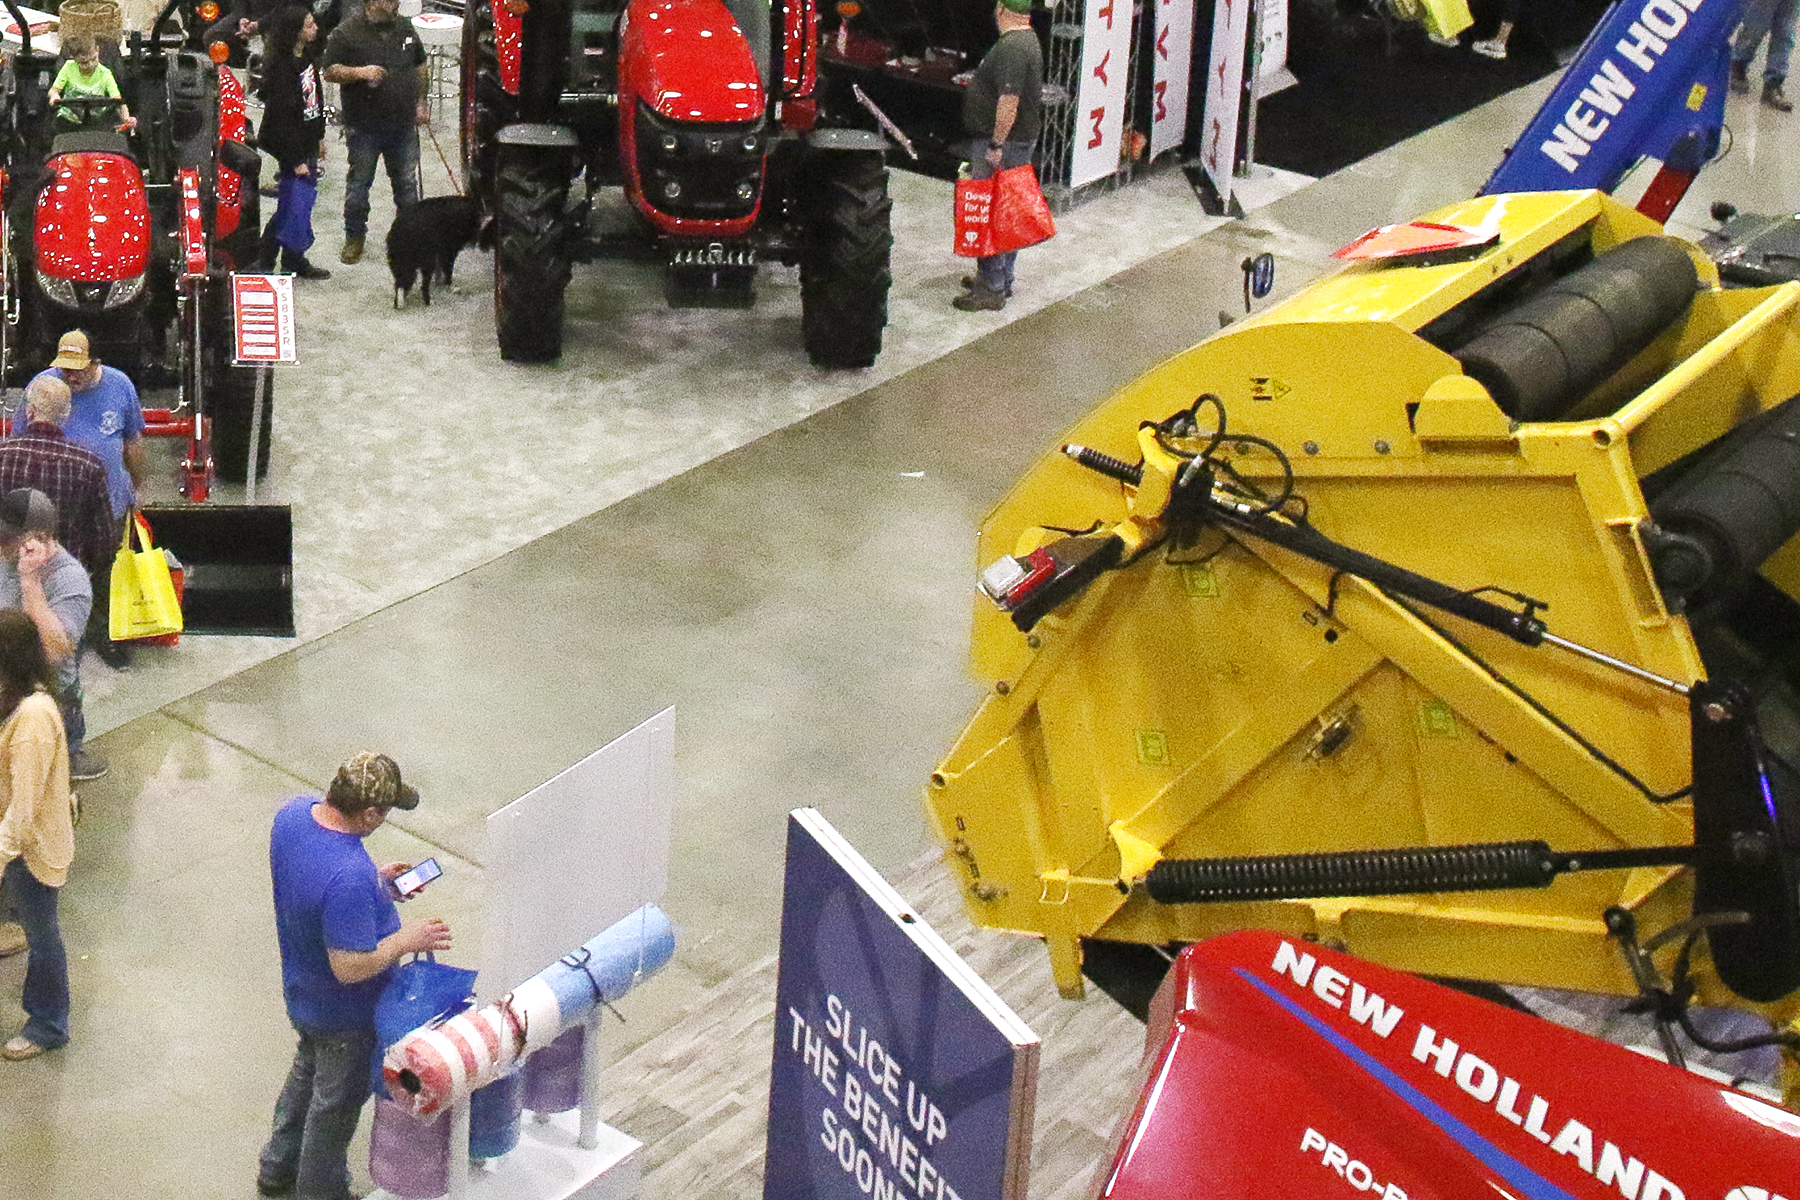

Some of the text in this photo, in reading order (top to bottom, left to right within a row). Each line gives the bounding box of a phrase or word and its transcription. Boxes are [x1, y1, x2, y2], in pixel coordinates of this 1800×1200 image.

[1541, 73, 1637, 174] NEW
[1272, 939, 1407, 1039] NEW
[789, 1007, 840, 1097] THE
[824, 994, 948, 1146] SLICE UP
[820, 1107, 907, 1200] SOON
